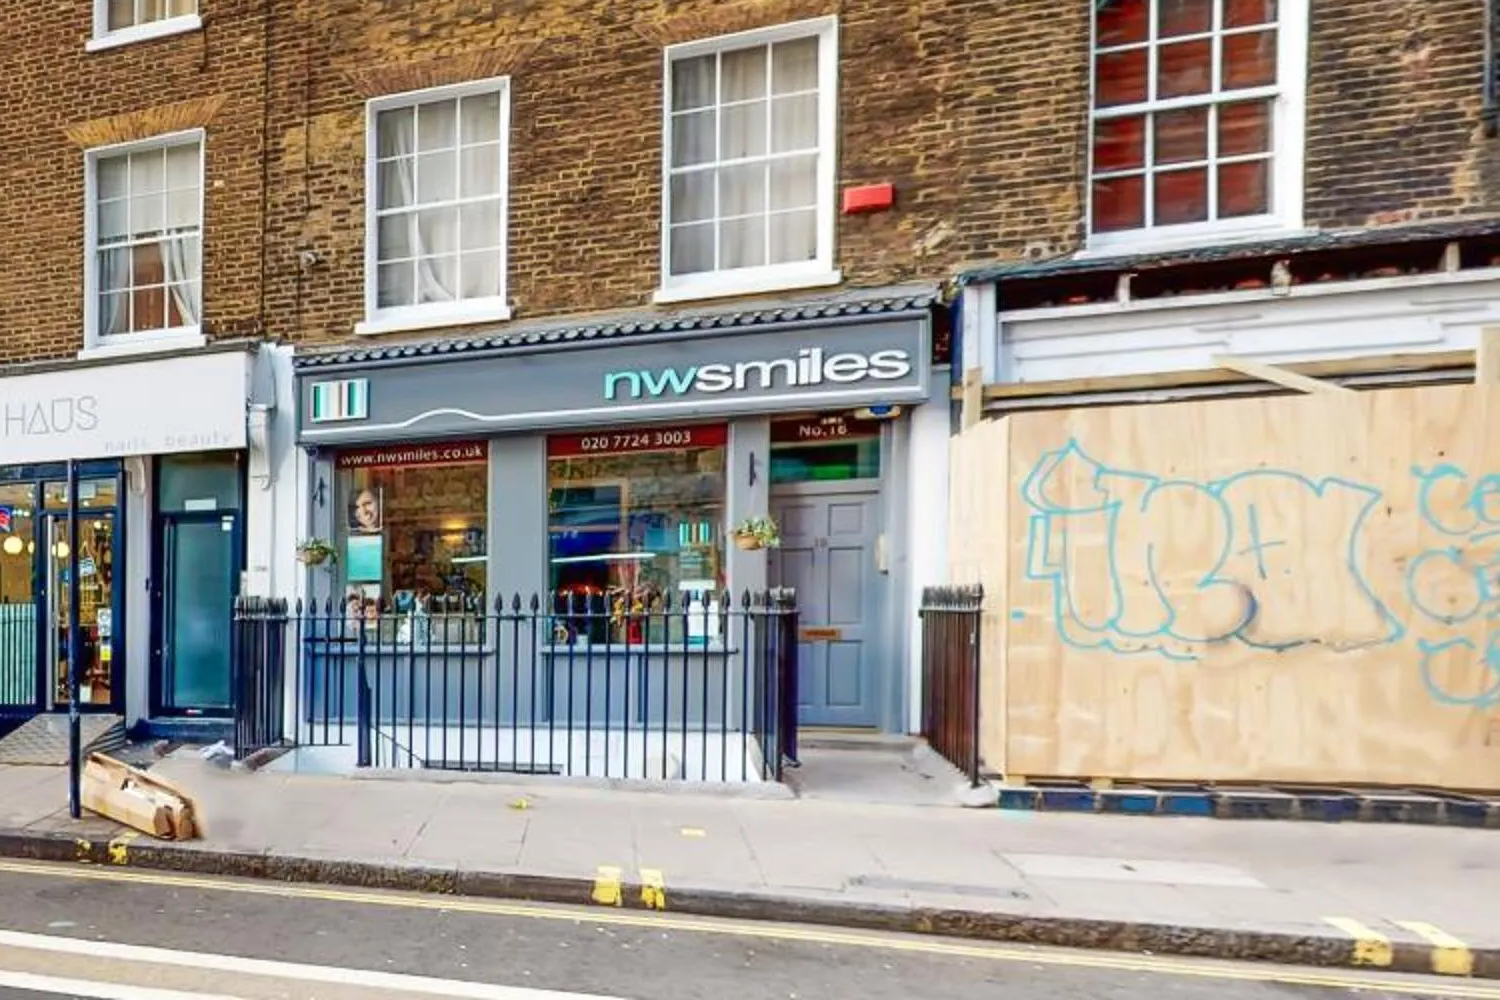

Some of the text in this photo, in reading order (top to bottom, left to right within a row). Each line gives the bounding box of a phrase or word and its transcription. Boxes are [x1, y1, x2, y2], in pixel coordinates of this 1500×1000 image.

[604, 347, 911, 400] nwsmiles
[4, 395, 100, 437] HAUS
[581, 431, 691, 449] 020 7724 3003
[340, 446, 483, 465] www.nwsmiles.co.uk
